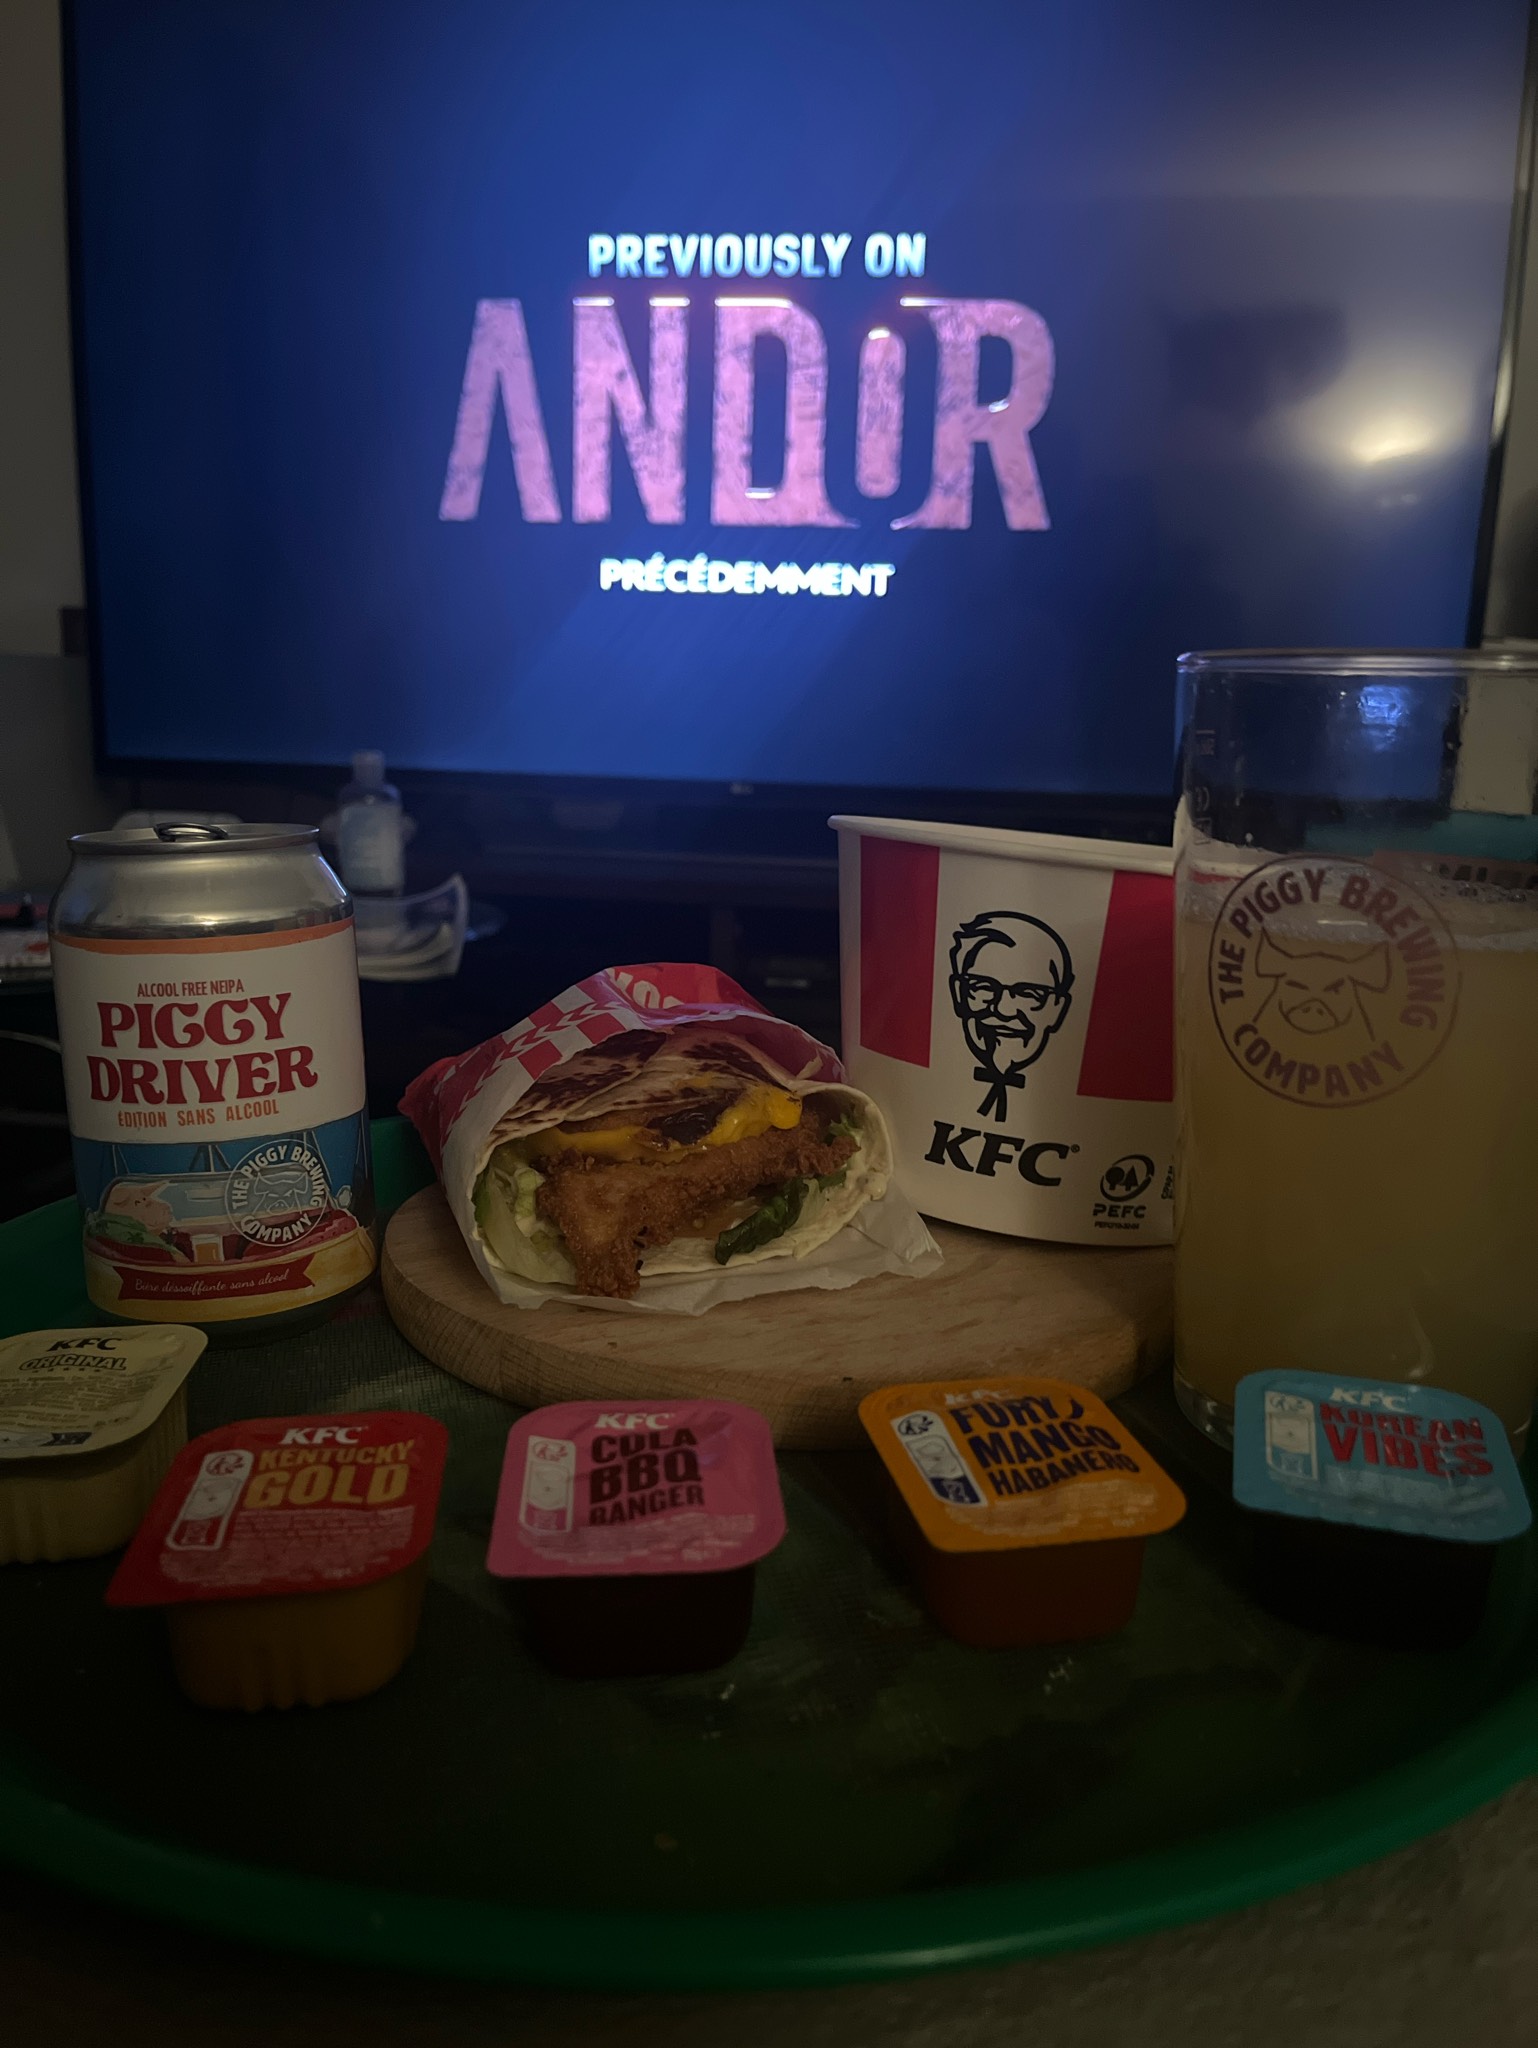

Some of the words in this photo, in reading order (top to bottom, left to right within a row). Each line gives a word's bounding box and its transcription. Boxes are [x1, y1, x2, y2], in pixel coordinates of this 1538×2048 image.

[588, 233, 852, 278] PREVIOUSLY
[863, 233, 927, 278] ON
[439, 298, 1056, 532] ANDOR
[599, 554, 896, 598] PRÉCÉDEMMENT
[1230, 868, 1325, 938] PIGGY
[1218, 939, 1245, 1003] THE
[1339, 875, 1445, 1031] BREWING
[137, 983, 179, 998] ALCOOL
[182, 981, 208, 996] FREE
[210, 979, 245, 995] NEIPA
[97, 992, 291, 1049] PIGGY
[87, 1045, 318, 1104] DRIVER
[1233, 1023, 1405, 1098] COMPANY
[177, 1108, 216, 1127] SANS
[226, 1099, 280, 1122] ALCOOL
[924, 1120, 1069, 1186] KFC
[231, 1179, 249, 1209] THE
[240, 1145, 288, 1179] PIGGY
[291, 1146, 325, 1207] BREWING
[241, 1213, 312, 1243] COMPANY
[1093, 1203, 1147, 1218] PEFC
[230, 1278, 256, 1290] sans
[258, 1268, 290, 1285] alcool
[19, 1353, 127, 1371] ORIGINAL
[46, 1337, 124, 1352] KFC
[594, 1413, 672, 1430] KFC
[950, 1396, 1059, 1434] FURY
[1320, 1401, 1484, 1443] KOREAN
[1329, 1387, 1408, 1413] KFC
[258, 1439, 415, 1472] KENTUCKY
[279, 1425, 362, 1446] KFC
[591, 1428, 698, 1464] COLA
[968, 1420, 1122, 1469] MANGO
[1323, 1423, 1494, 1478] VIBES
[243, 1462, 411, 1510] GOLD
[590, 1449, 702, 1505] BBQ
[987, 1449, 1140, 1498] HABANERO
